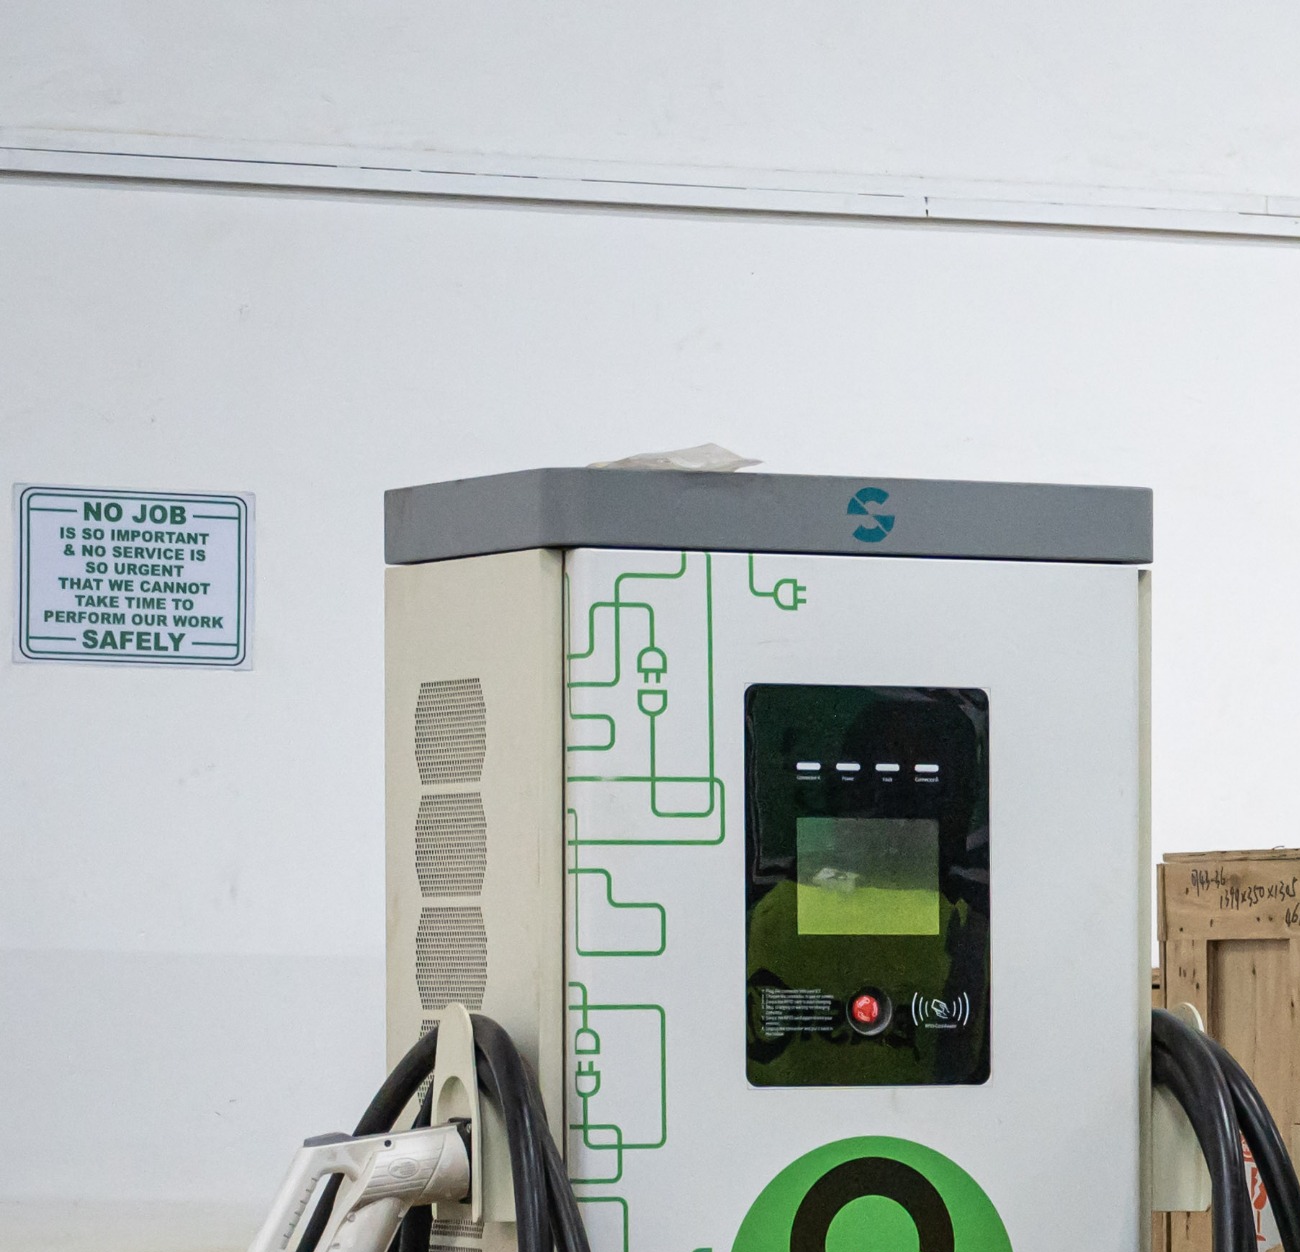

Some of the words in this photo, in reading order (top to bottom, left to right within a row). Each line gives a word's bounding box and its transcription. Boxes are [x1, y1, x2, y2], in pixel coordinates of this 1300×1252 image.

[83, 501, 123, 522] NO
[131, 504, 187, 525] JOB
[59, 527, 76, 539] IS
[82, 528, 105, 541] SO
[111, 529, 210, 545] IMPORTANT
[63, 543, 75, 556] &
[82, 545, 106, 557] NO
[112, 546, 184, 561] SERVICE
[190, 549, 206, 562] IS
[85, 561, 108, 574] SO
[114, 562, 184, 577] URGENT
[58, 577, 103, 590] THAT
[108, 579, 134, 592] WE
[140, 580, 211, 595] CANNOT
[75, 594, 119, 607] TAKE
[125, 596, 166, 610] TIME
[172, 598, 194, 611] TO
[44, 610, 126, 625] PERFORM
[131, 613, 168, 627] OUR
[173, 615, 224, 629] WORK
[82, 629, 186, 652] SAFELY
